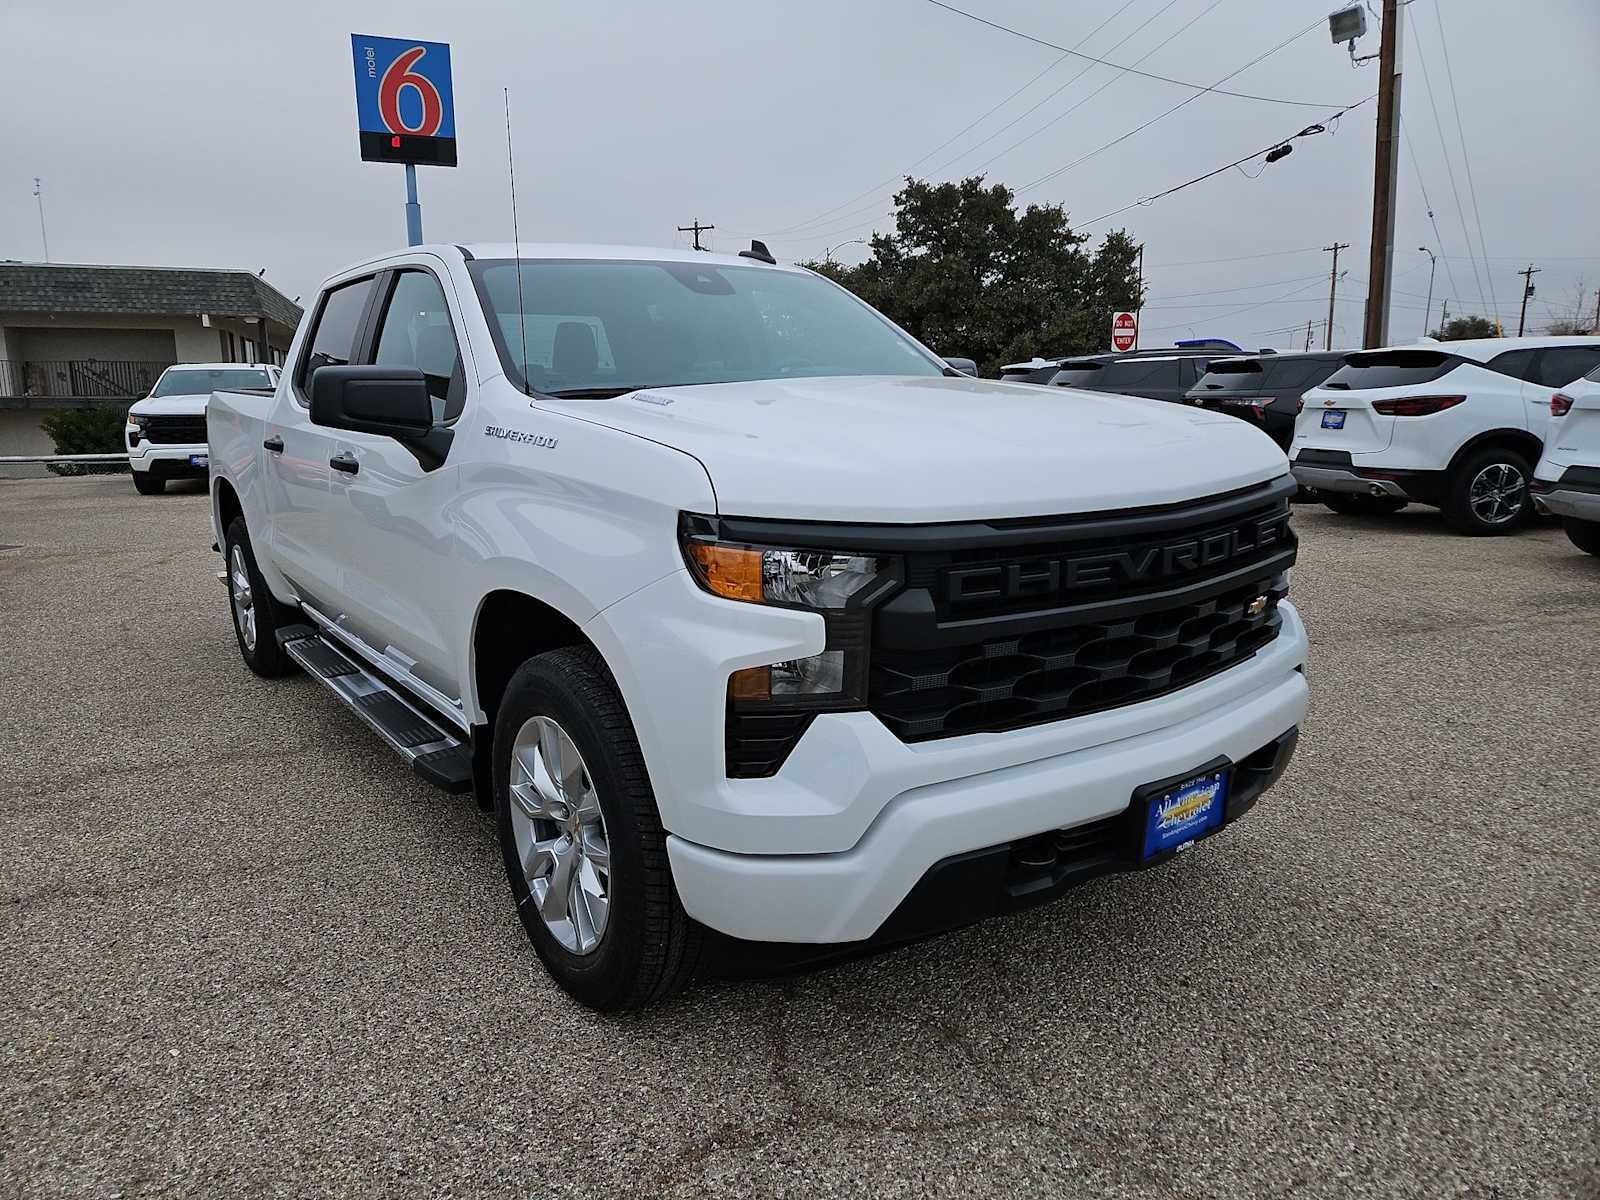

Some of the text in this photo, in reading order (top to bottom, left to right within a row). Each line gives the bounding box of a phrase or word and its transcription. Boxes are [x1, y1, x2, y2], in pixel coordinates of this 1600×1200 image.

[365, 47, 377, 78] motel
[378, 46, 443, 136] 6
[484, 425, 559, 449] SILVERADO
[946, 511, 1293, 602] CHEVROLET
